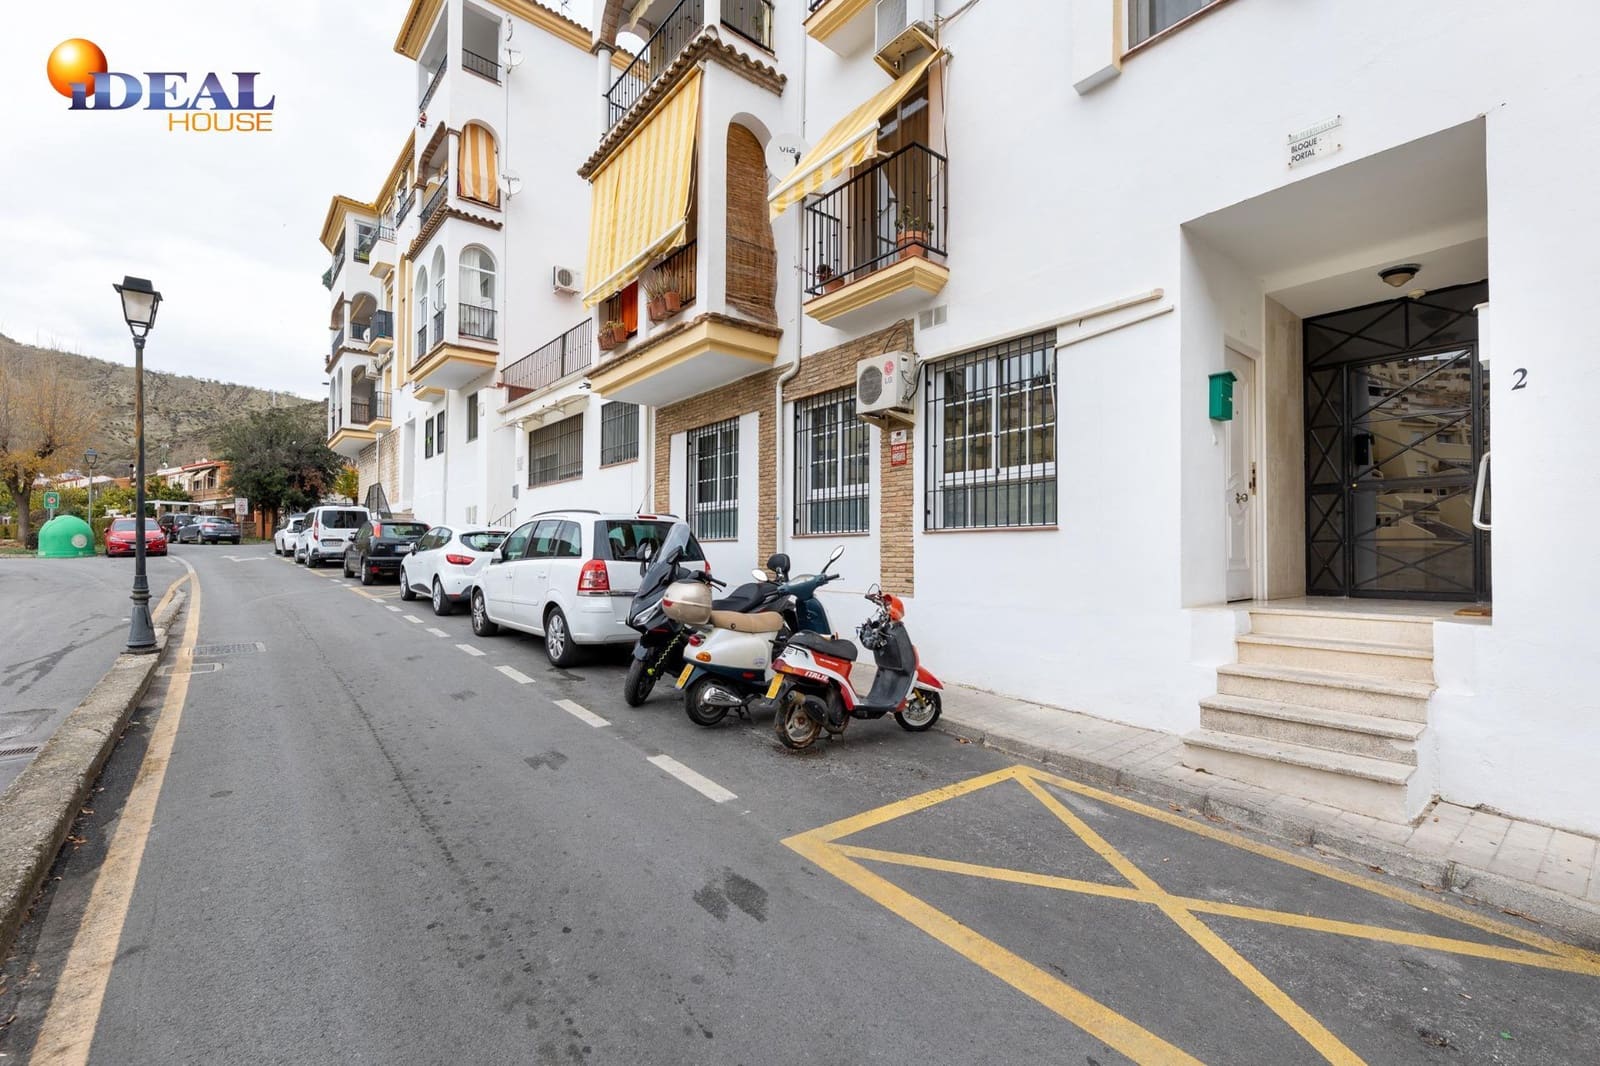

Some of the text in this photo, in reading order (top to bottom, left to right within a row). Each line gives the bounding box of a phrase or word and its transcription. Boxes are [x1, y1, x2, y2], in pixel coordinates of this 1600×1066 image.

[1291, 137, 1317, 153] BLOQUE
[1291, 148, 1315, 162] PORTAL
[884, 376, 893, 385] LG
[1511, 367, 1528, 391] 2
